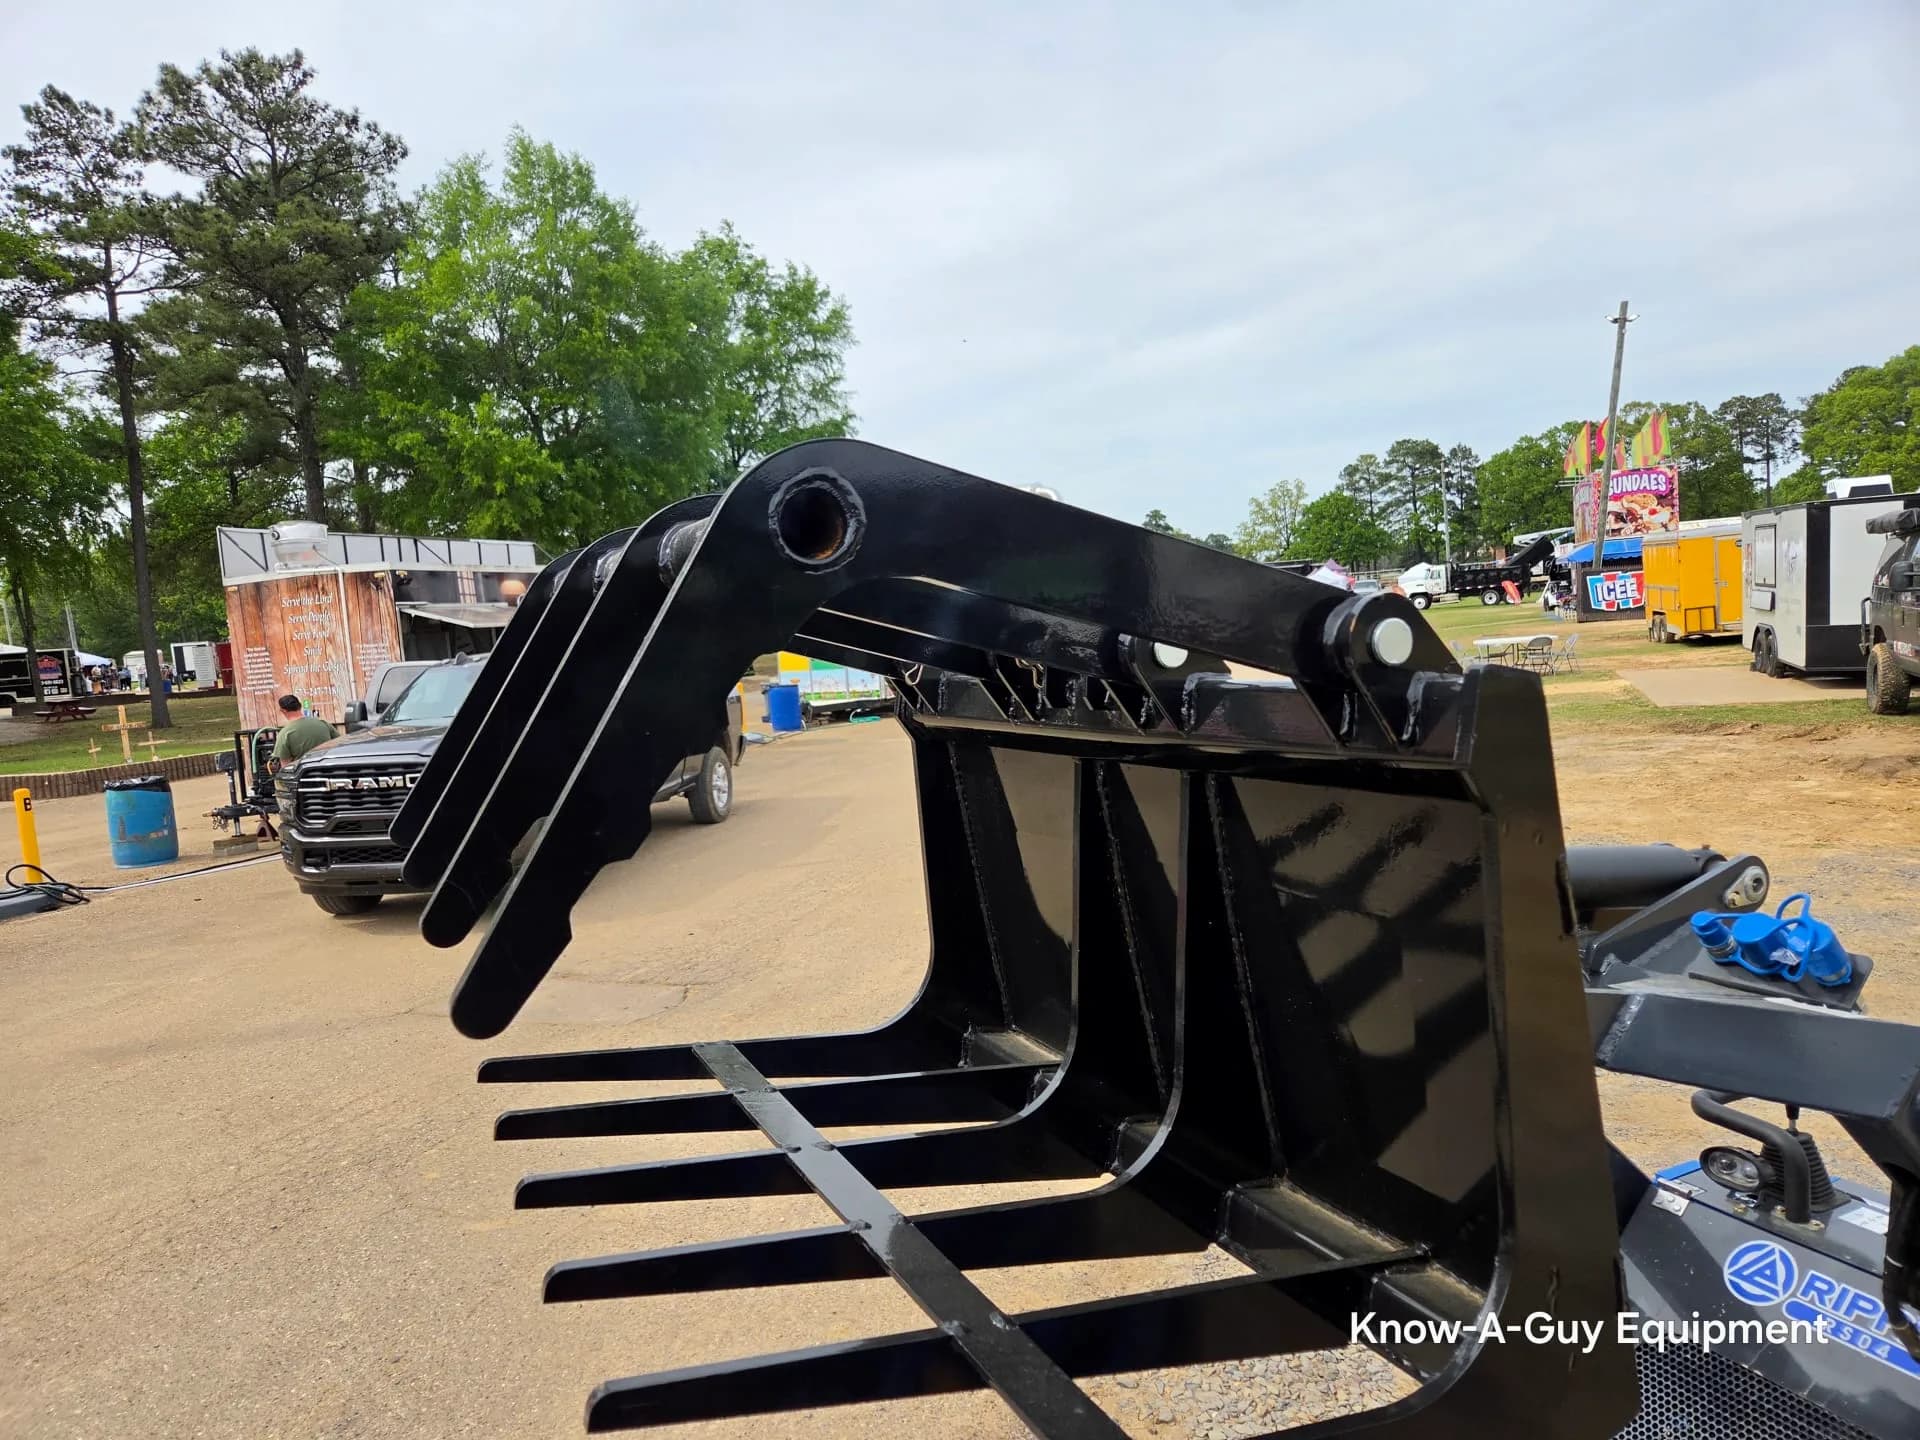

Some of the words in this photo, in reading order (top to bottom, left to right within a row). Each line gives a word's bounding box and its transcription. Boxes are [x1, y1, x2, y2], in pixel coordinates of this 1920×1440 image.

[1596, 577, 1639, 603] ICEE
[330, 775, 404, 791] RAM
[23, 797, 33, 811] B
